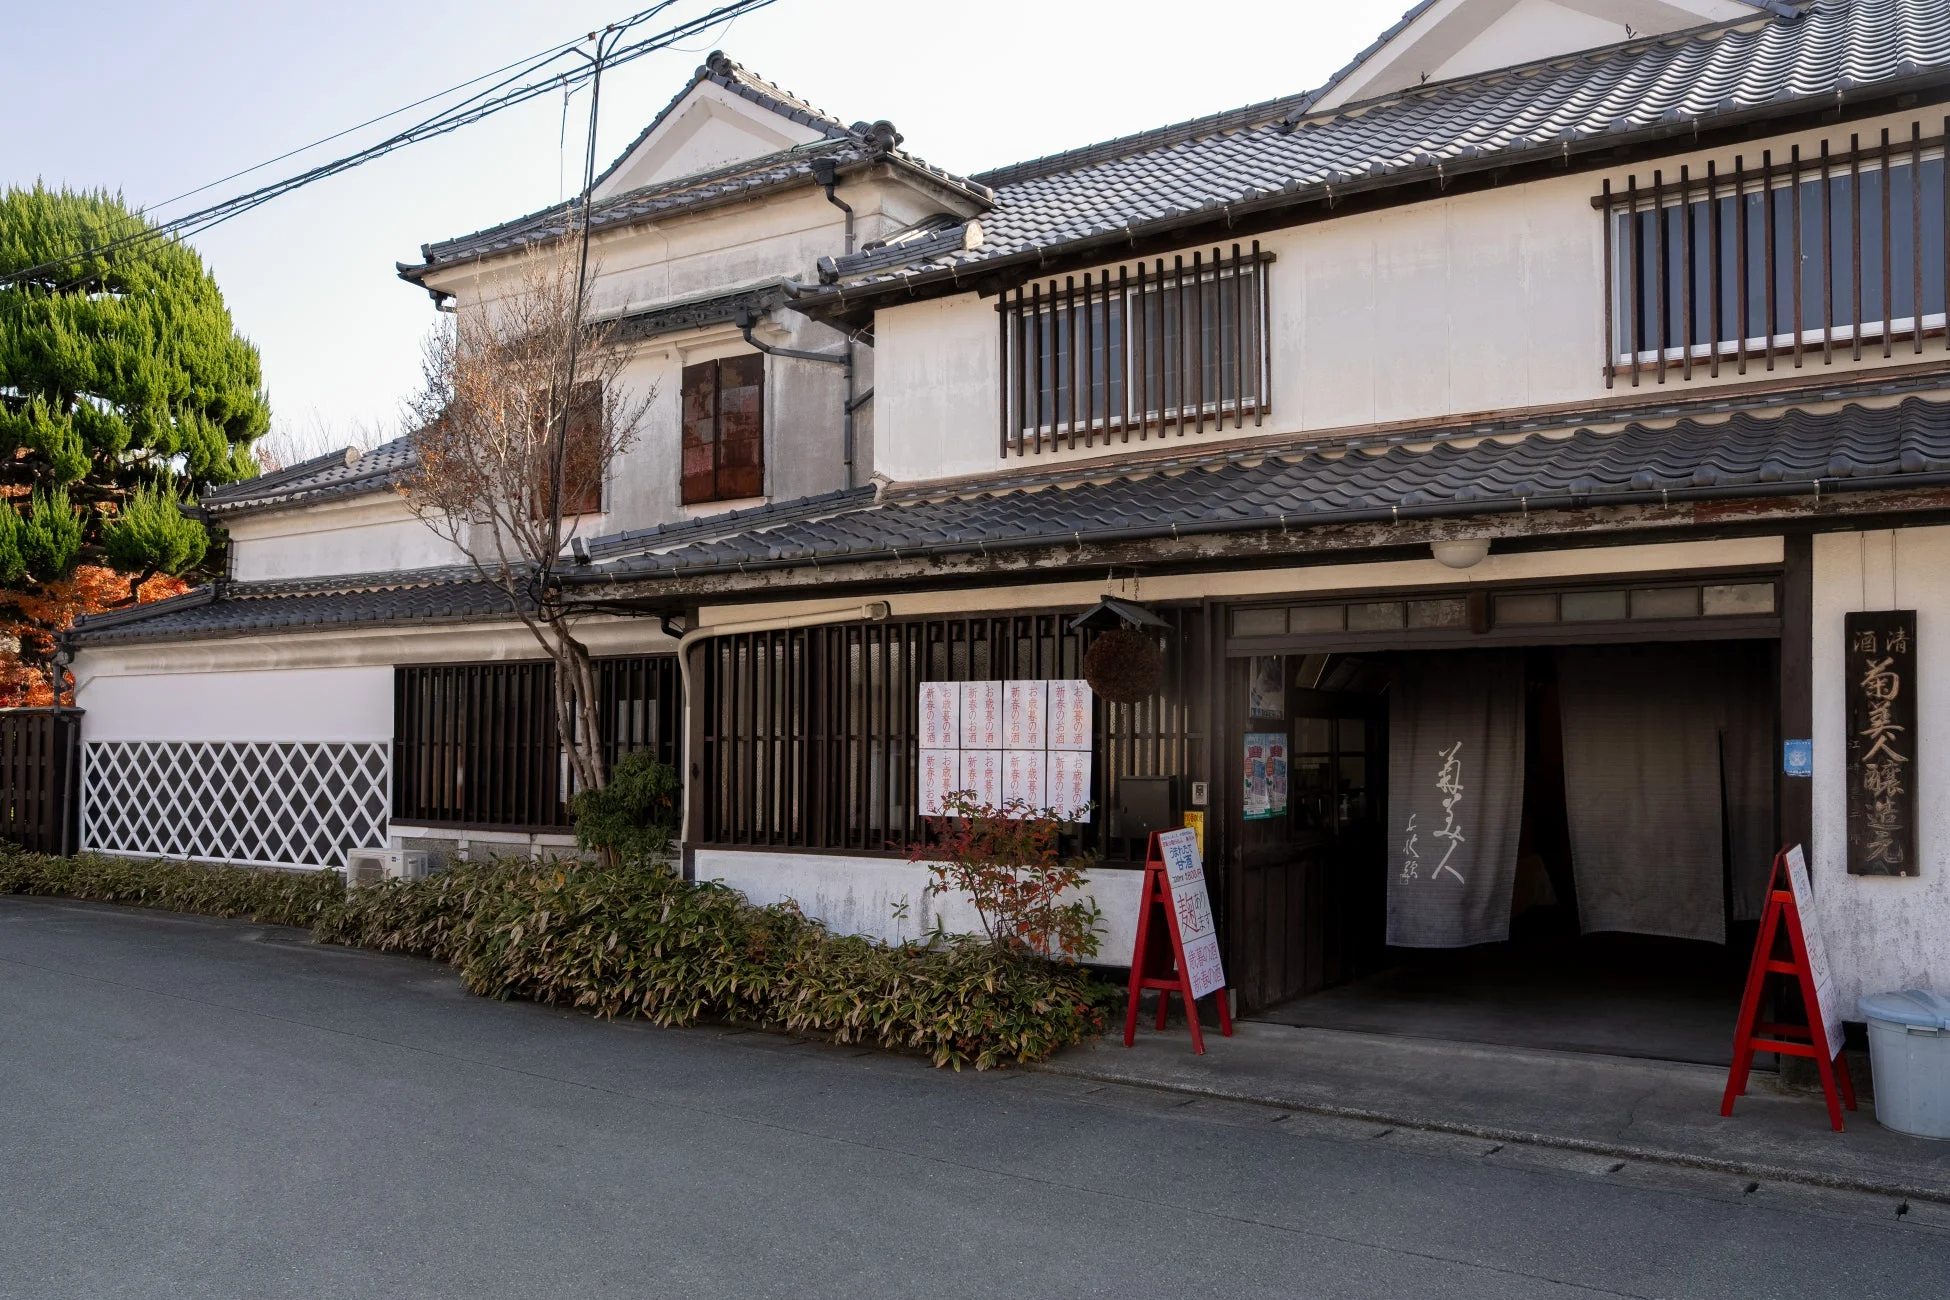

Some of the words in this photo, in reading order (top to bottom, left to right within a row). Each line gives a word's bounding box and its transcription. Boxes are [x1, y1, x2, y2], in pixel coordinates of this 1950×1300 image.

[926, 687, 936, 743] 新春のお酒
[942, 687, 952, 743] お歳暮の酒
[968, 687, 977, 743] 新春のお酒
[984, 686, 994, 743] お歳暮の酒
[1010, 686, 1020, 743] 新春のお酒
[1027, 686, 1038, 743] お歳暮の酒
[1055, 686, 1065, 744] 新春のお酒
[1073, 685, 1083, 744] お歳暮の酒
[926, 755, 935, 811] 新春のお酒
[1055, 757, 1065, 815] 新春のお酒
[1431, 741, 1466, 885] 菊美人
[1175, 854, 1194, 871] 甘酒
[1188, 941, 1219, 969] 歳暮の酒
[1193, 965, 1223, 993] 新春の酒
